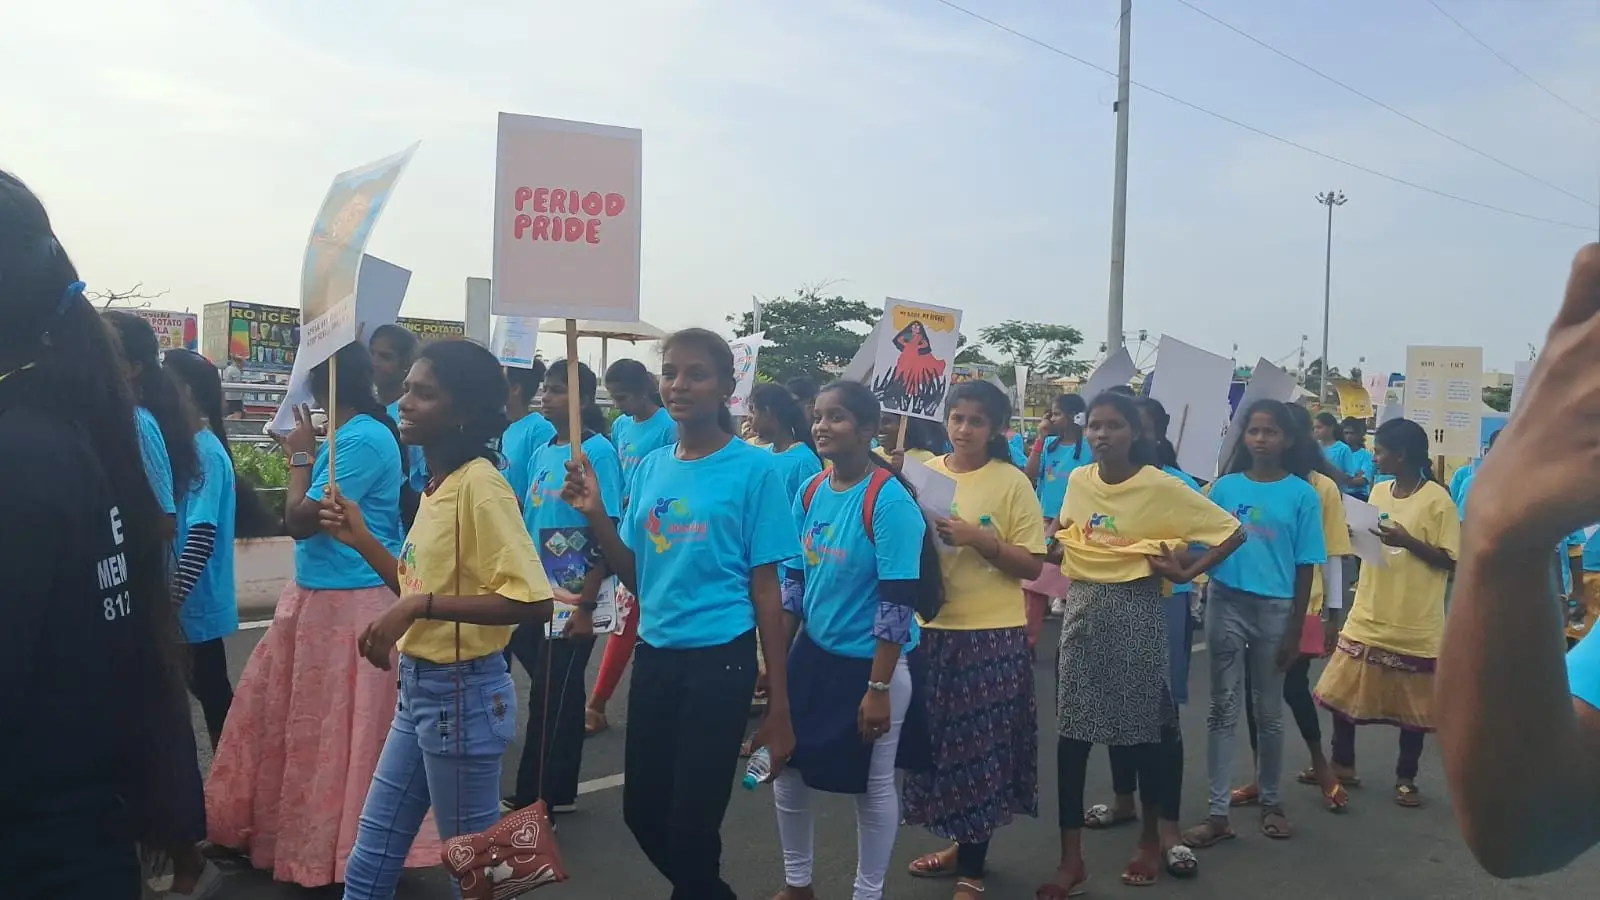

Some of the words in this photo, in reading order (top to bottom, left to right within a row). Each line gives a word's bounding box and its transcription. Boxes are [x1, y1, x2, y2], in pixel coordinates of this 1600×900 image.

[514, 186, 625, 217] PERIOD
[514, 214, 601, 244] PRIDE
[152, 318, 182, 327] POTATO
[231, 308, 256, 320] RO
[261, 311, 292, 324] ICE
[424, 325, 463, 334] POTATO
[97, 552, 128, 589] MEN
